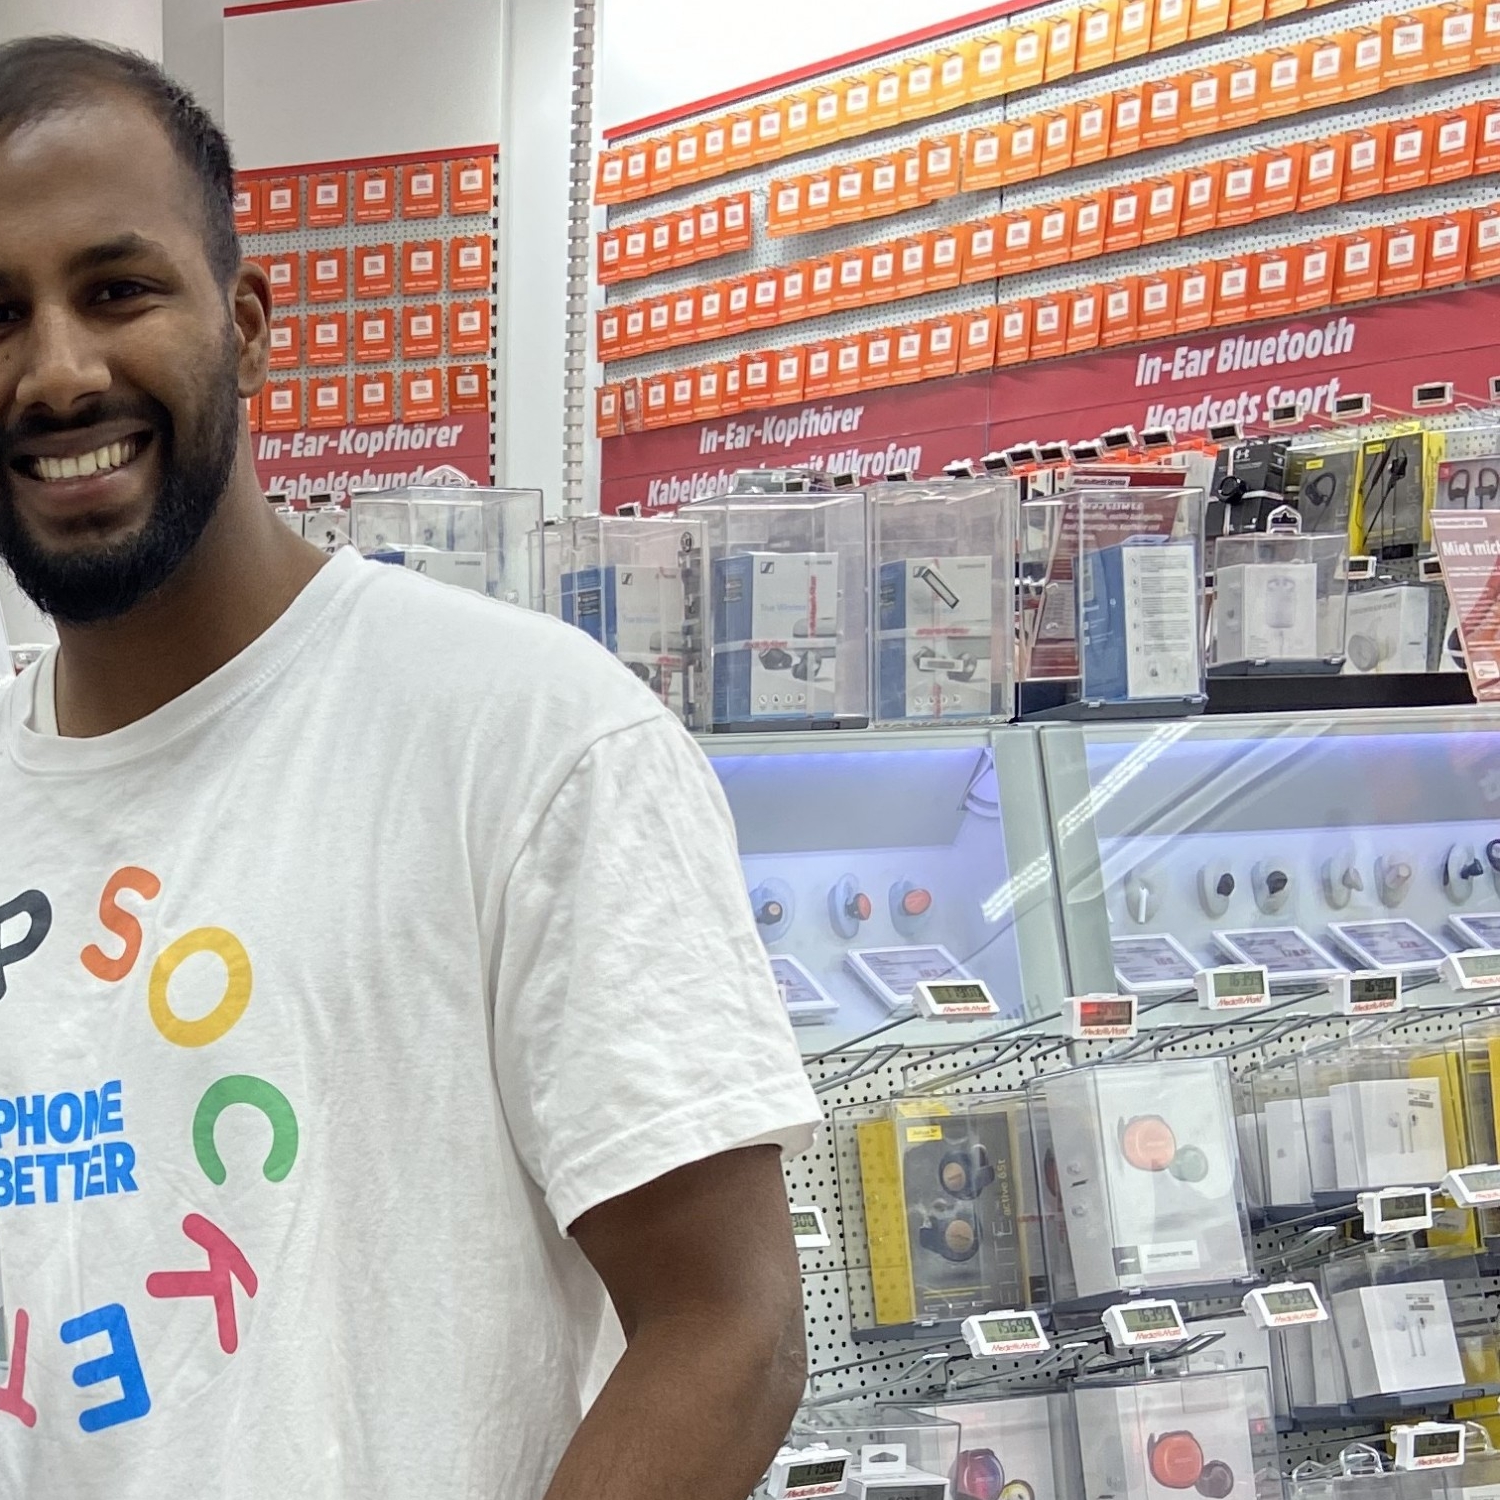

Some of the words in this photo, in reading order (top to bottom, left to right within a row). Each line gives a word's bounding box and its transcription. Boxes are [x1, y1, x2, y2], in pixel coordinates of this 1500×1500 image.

[1135, 345, 1214, 387] In-Ear
[1216, 316, 1355, 374] Bluetooth
[699, 406, 864, 454] In-Ear-Kopfhörer
[1145, 391, 1260, 433] Headsets
[258, 423, 463, 460] In-Ear-Kopfhörer
[826, 442, 921, 477] Mikrofon
[1442, 541, 1471, 556] Miet
